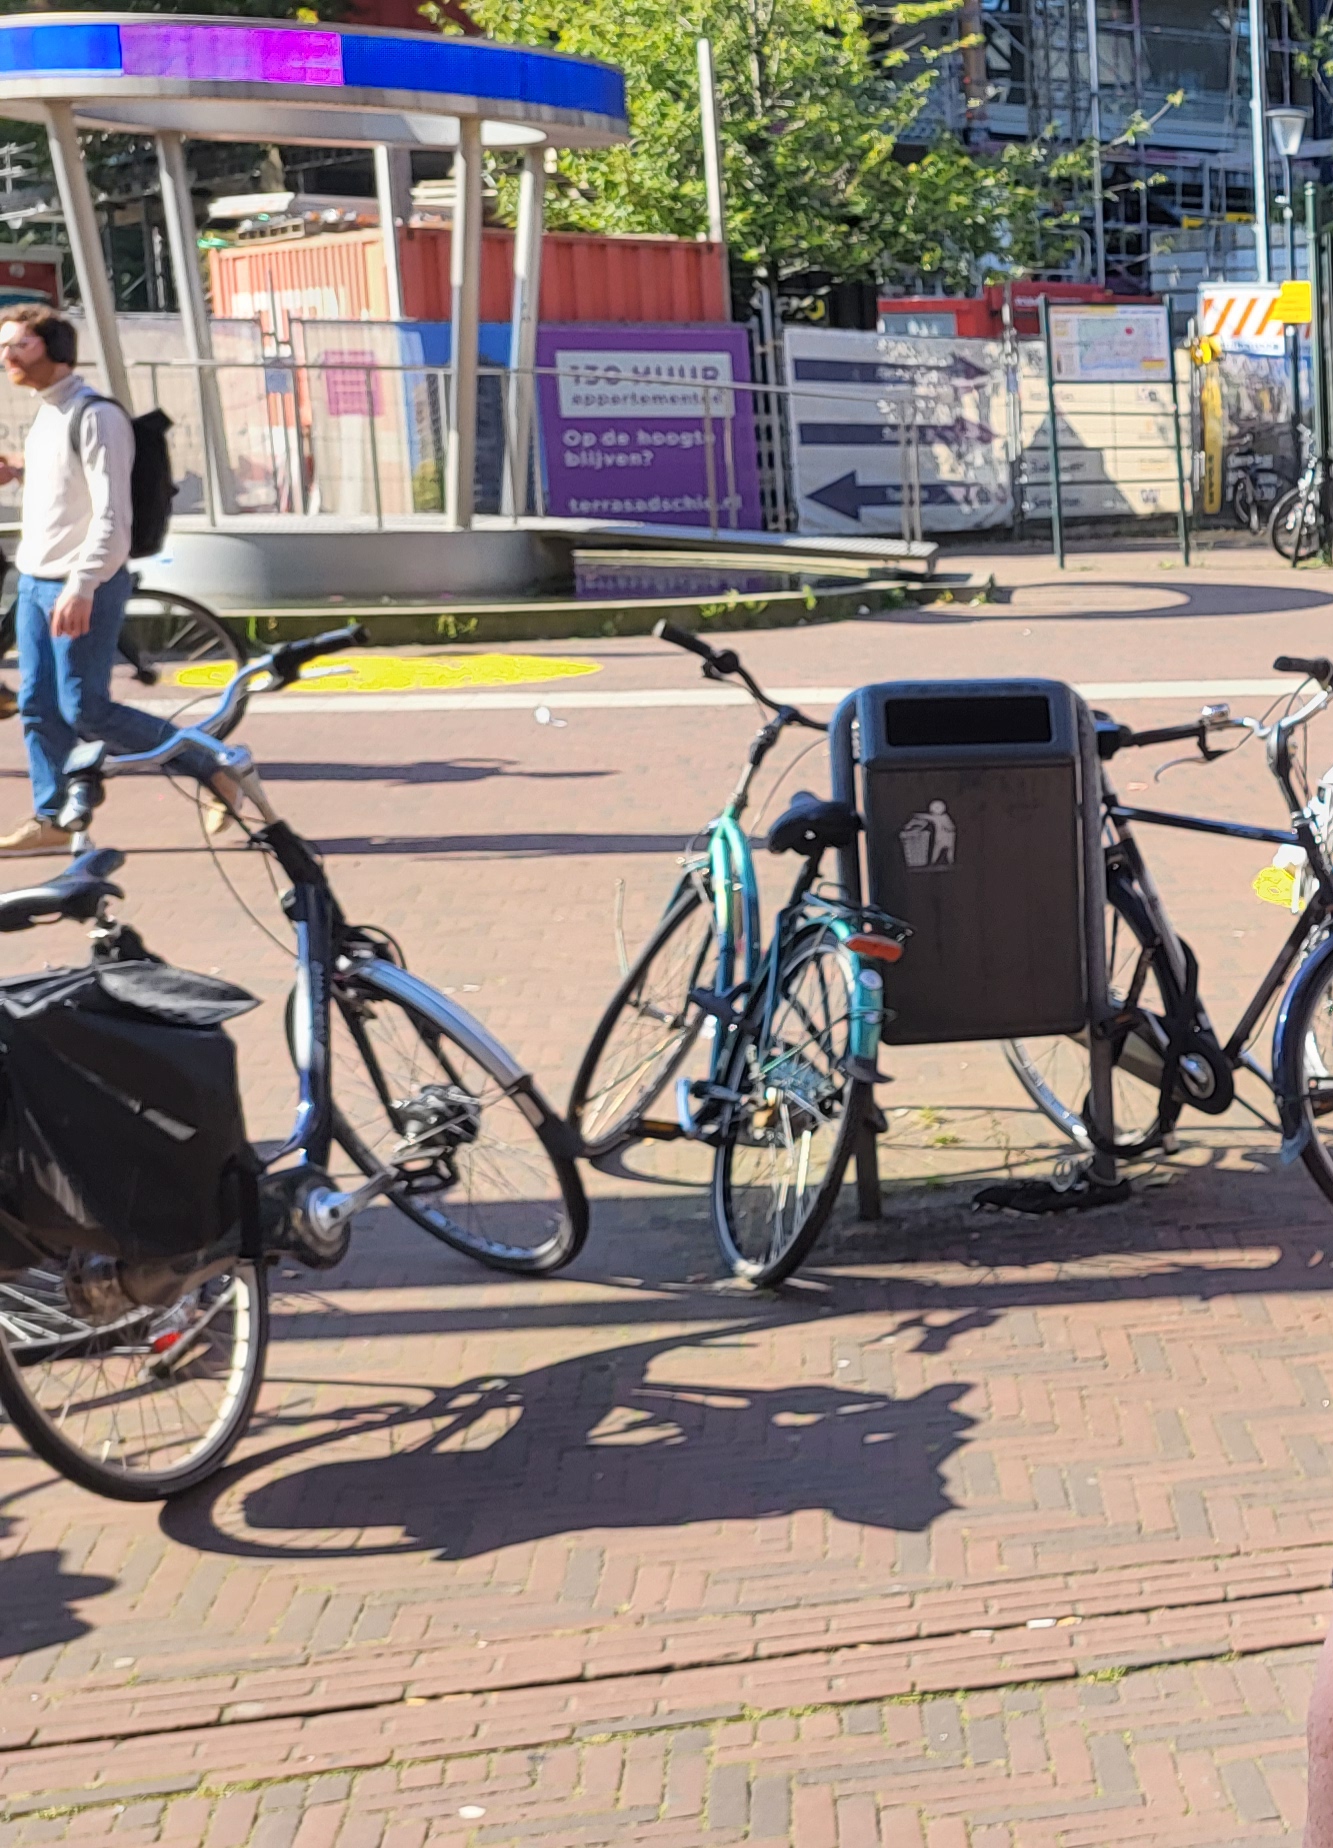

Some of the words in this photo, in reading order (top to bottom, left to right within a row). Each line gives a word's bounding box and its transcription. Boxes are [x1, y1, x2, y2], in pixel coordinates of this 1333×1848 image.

[562, 428, 597, 448] Op
[601, 427, 631, 447] de
[563, 449, 655, 470] blijven?
